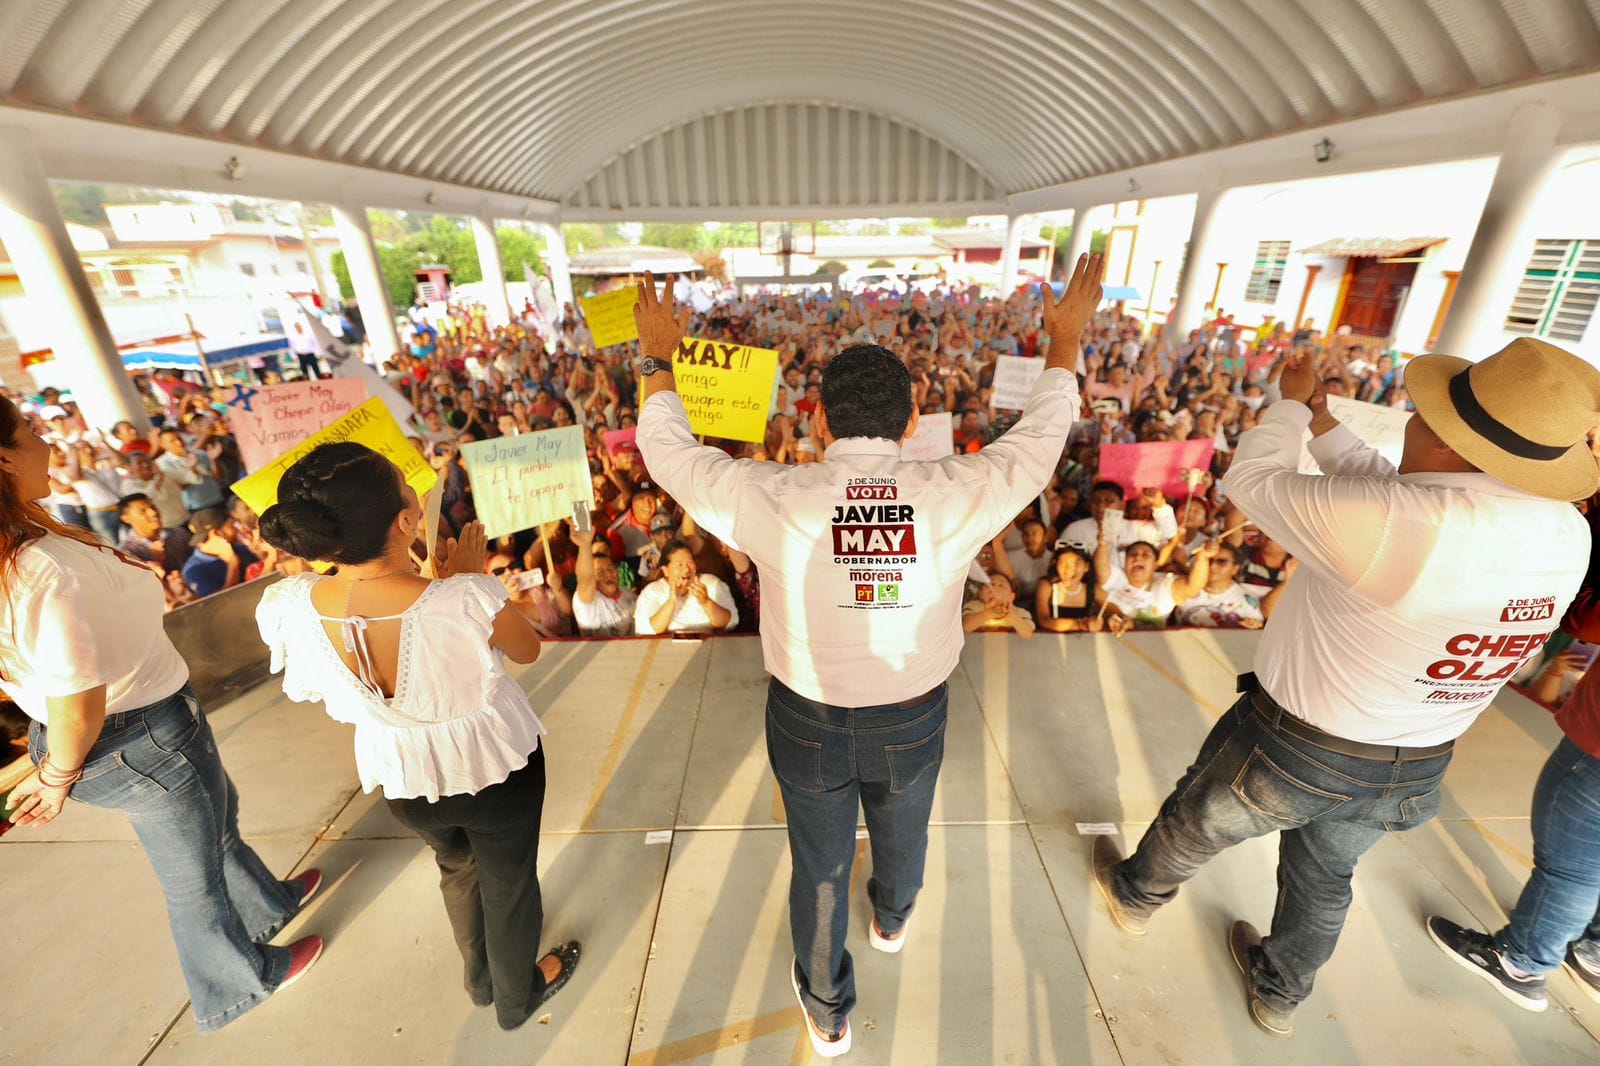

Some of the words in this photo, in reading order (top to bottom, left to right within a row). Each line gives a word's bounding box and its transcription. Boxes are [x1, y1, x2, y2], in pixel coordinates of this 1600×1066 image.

[681, 374, 718, 389] migo
[679, 394, 724, 407] nuapa
[686, 407, 723, 425] ntigo
[847, 478, 853, 486] 2
[854, 477, 868, 485] DE
[868, 477, 897, 486] JUNIO
[848, 487, 895, 499] VOTA
[832, 505, 914, 523] JAVIER
[840, 529, 906, 552] MAY
[834, 557, 917, 565] GOBERNADOR
[849, 571, 903, 582] morena
[857, 590, 873, 600] PT
[1515, 599, 1529, 607] DE
[1530, 596, 1556, 606] JUNIO
[1507, 606, 1551, 620] VOTA
[1445, 633, 1551, 658] CHEP
